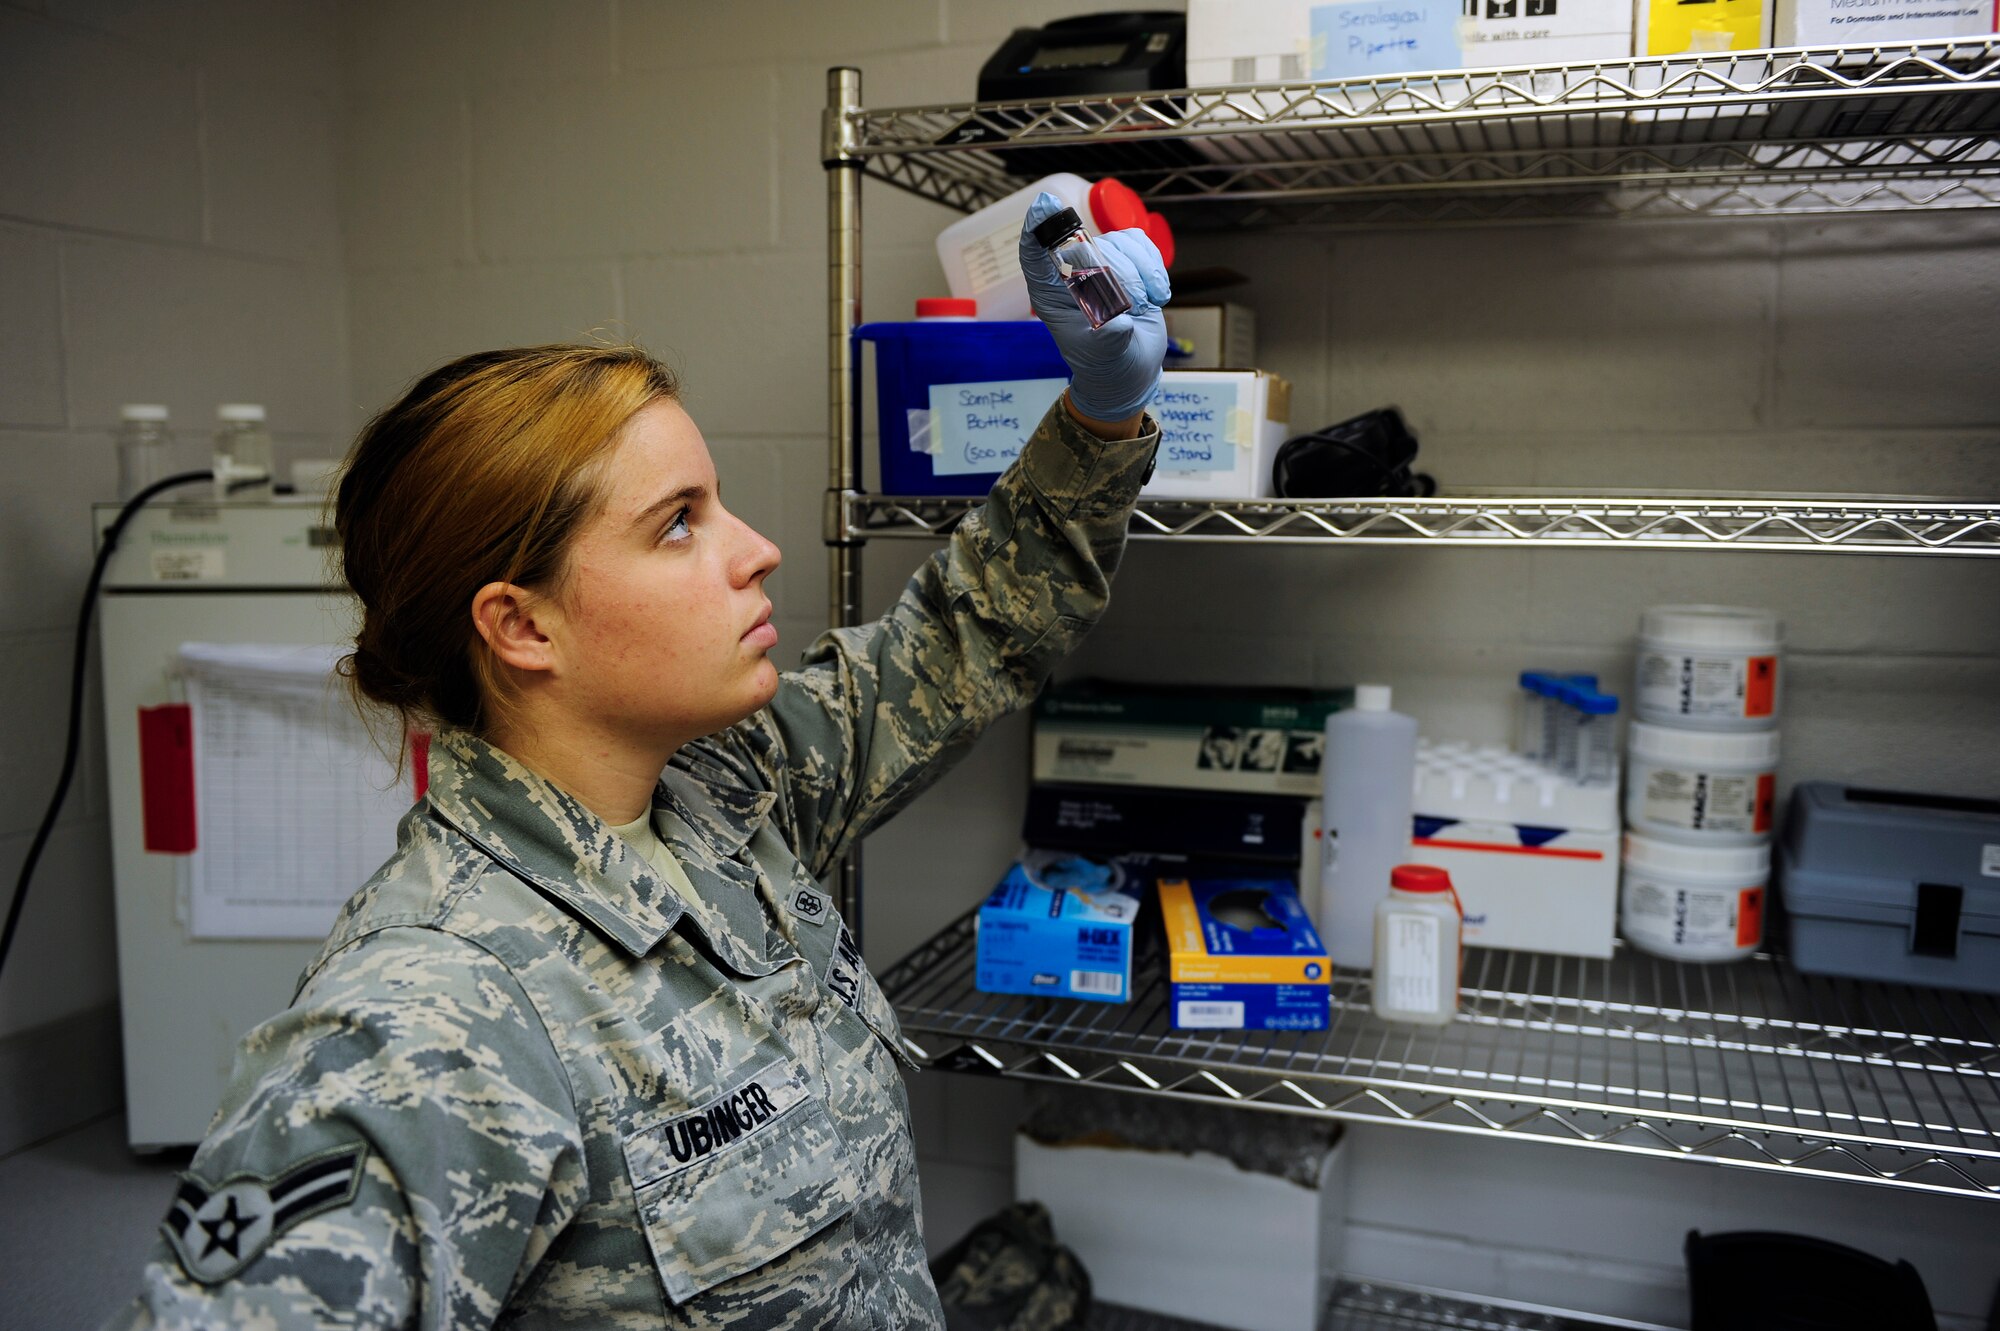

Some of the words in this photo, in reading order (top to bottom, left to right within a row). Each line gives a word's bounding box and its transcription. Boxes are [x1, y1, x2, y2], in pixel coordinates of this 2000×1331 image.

[1339, 8, 1428, 30] Serological
[1846, 15, 1886, 23] Domestic
[1887, 13, 1905, 21] and
[1906, 10, 1961, 19] International
[1523, 29, 1551, 39] care
[1348, 36, 1418, 59] Pipette
[1078, 273, 1088, 282] 10
[959, 390, 1014, 409] Sample
[966, 413, 1020, 430] Bottles
[1161, 408, 1215, 430] Magnetic
[964, 441, 997, 464] (500
[1168, 445, 1212, 461] Stand
[1680, 656, 1693, 715] HACH
[1693, 773, 1708, 831] HACH
[1674, 887, 1687, 945] HACH
[665, 1082, 778, 1163] UBINGER
